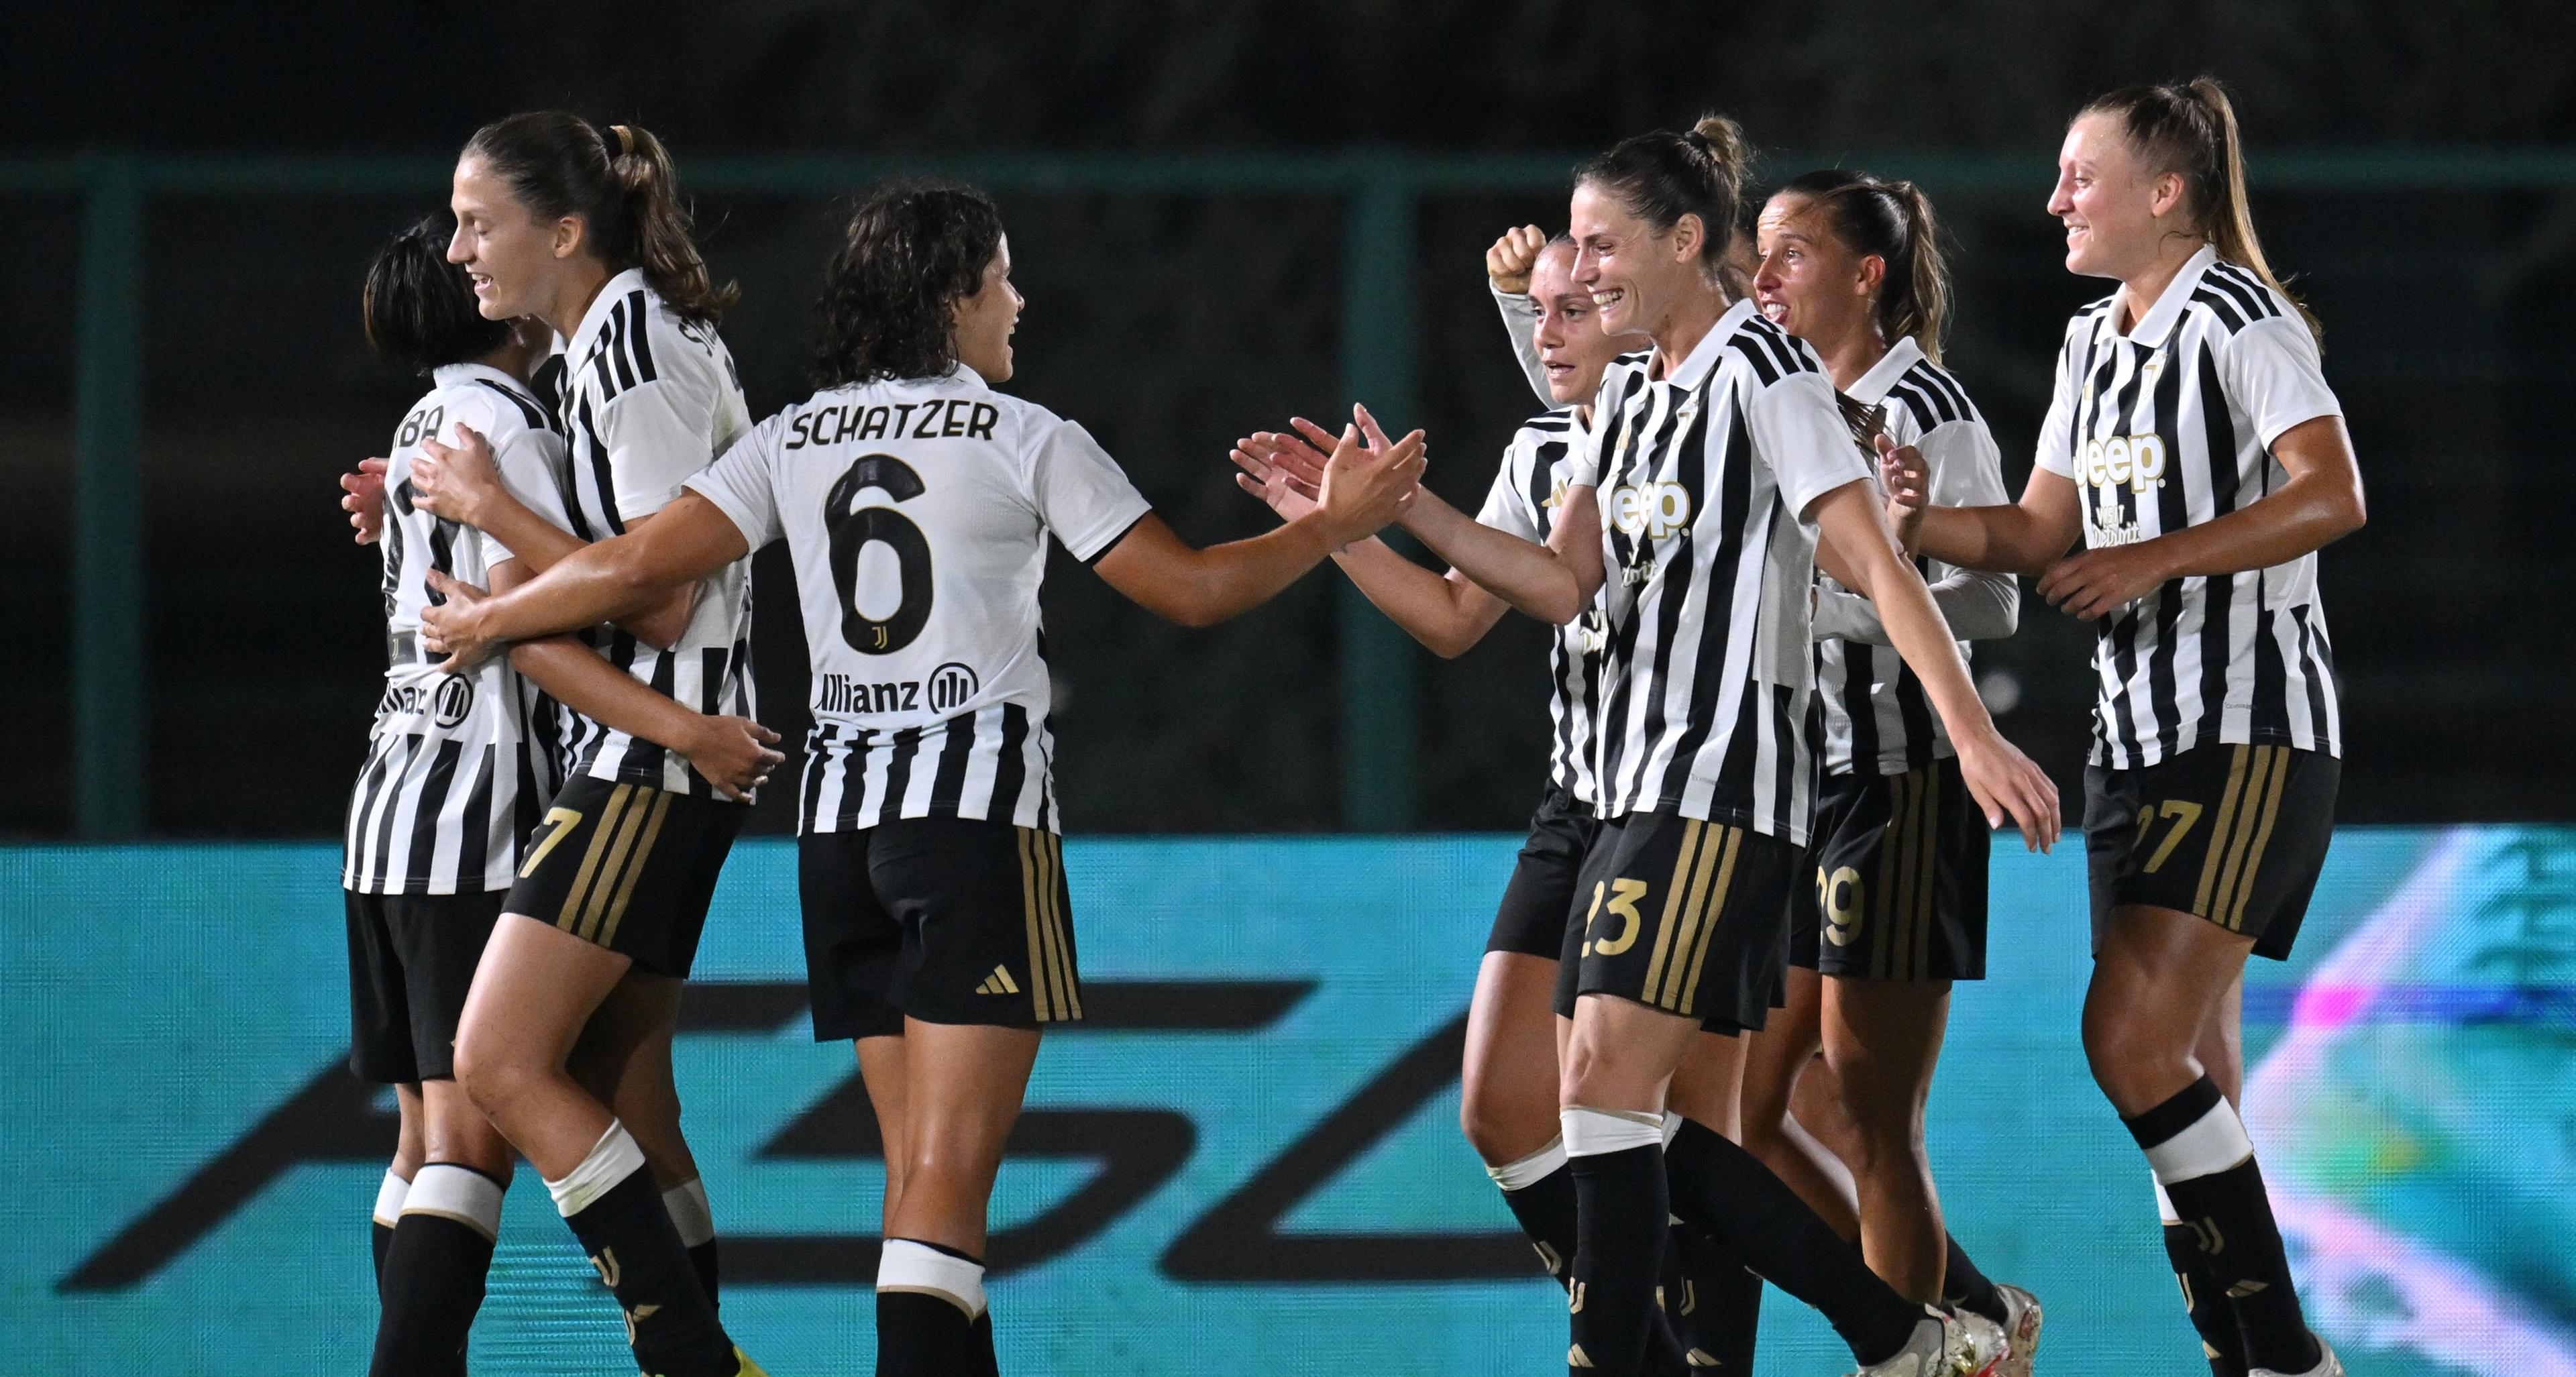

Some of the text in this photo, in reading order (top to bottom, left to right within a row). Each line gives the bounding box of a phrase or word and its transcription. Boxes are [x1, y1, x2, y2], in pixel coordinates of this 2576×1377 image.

[786, 400, 1000, 450] SCHATZER
[2072, 426, 2167, 494] Jeep
[824, 453, 934, 655] 6
[814, 673, 920, 714] Allianz
[524, 806, 583, 879] 7
[1582, 878, 1648, 958] 23
